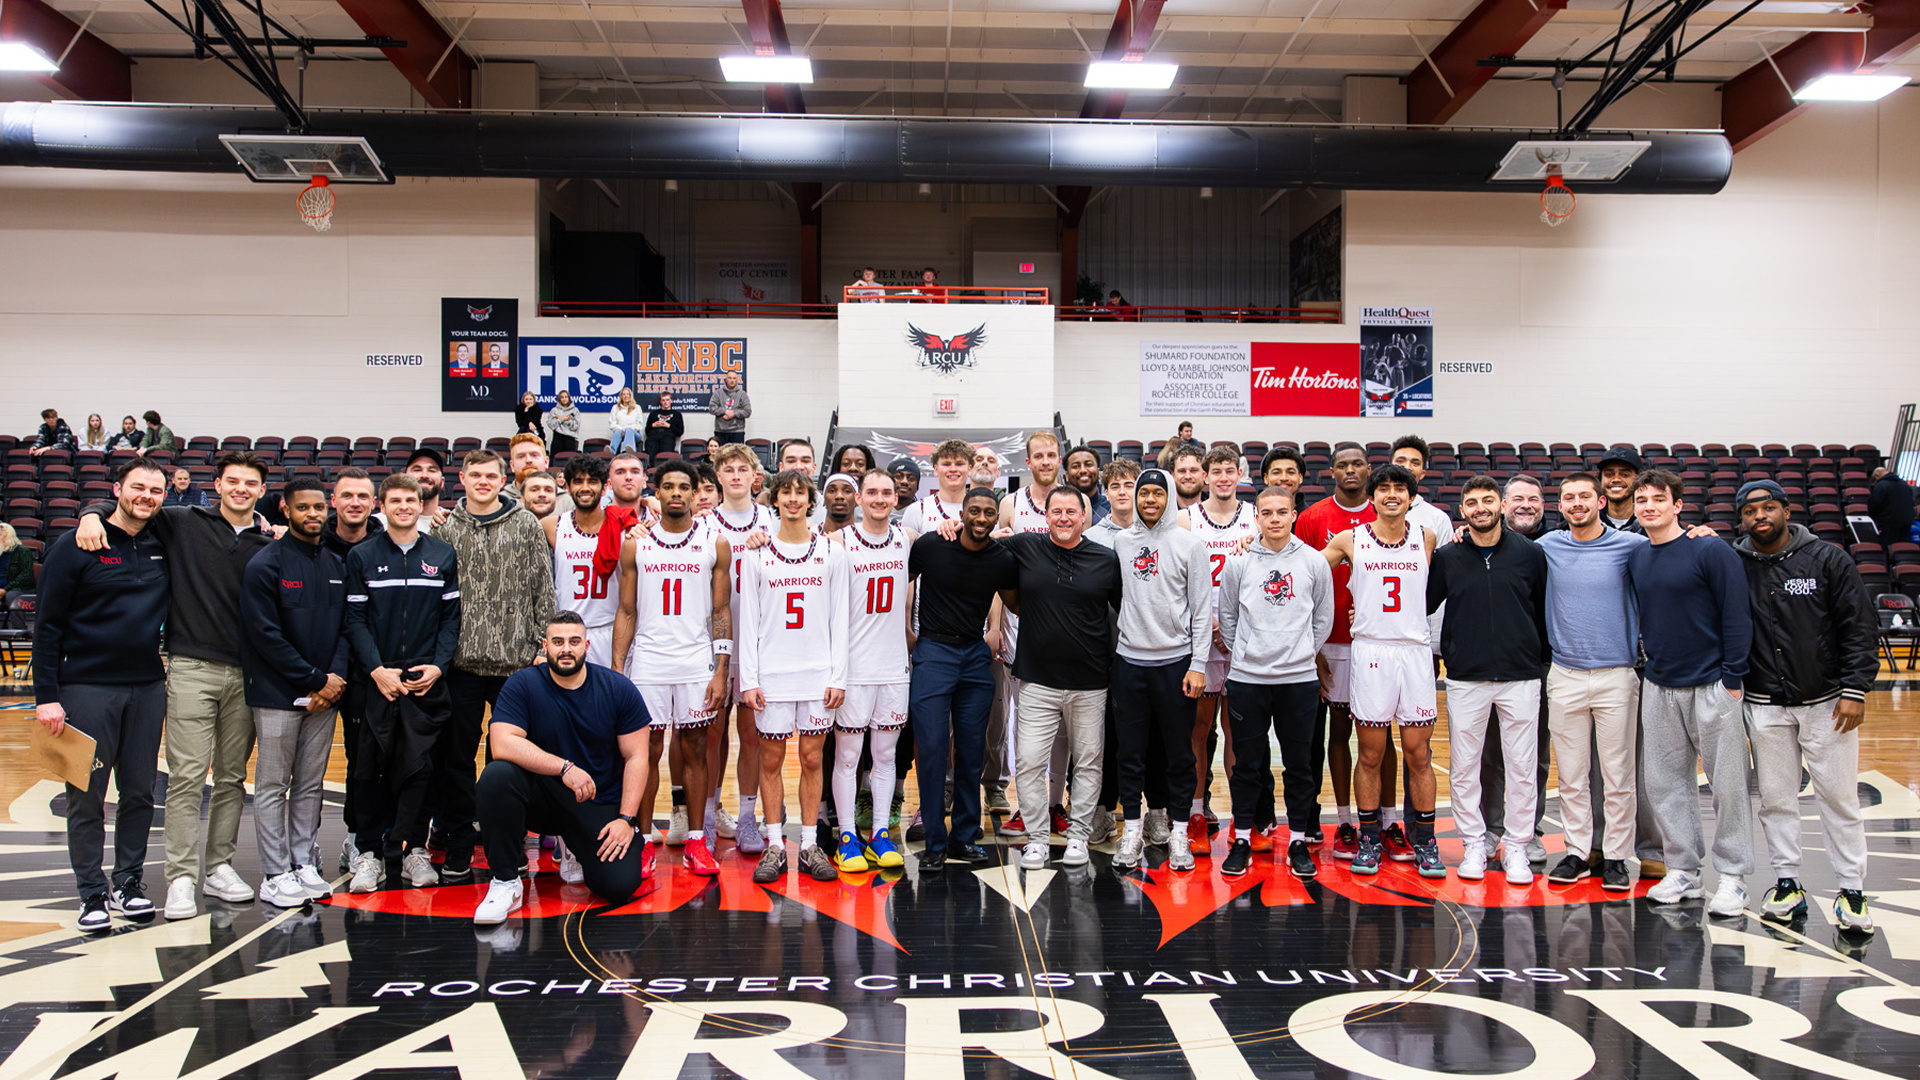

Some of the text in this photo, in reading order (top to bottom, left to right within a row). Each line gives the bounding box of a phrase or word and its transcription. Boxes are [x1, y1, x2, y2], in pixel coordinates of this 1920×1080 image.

[718, 269, 788, 278] GOLF CENTER
[853, 270, 941, 279] CTER FAMY
[1364, 308, 1430, 320] HealthQuest
[366, 355, 422, 366] RESERVED
[638, 341, 742, 372] LNBC
[932, 352, 961, 363] RCU
[1145, 352, 1188, 360] SHUMARD
[1209, 364, 1249, 372] JOHNSON
[1440, 362, 1492, 372] RESERVED
[637, 374, 742, 384] LAKE NORCENTA
[1252, 366, 1286, 388] Tim
[637, 384, 710, 394] BASKETBALL
[940, 400, 954, 410] EXIT
[566, 551, 593, 560] WARR
[644, 564, 700, 573] WARRIORS
[854, 560, 903, 574] WARRIORS
[1365, 562, 1418, 571] WARRIORS
[573, 565, 608, 600] 30
[769, 576, 822, 588] WARRIORS
[662, 578, 682, 615] 11
[866, 576, 893, 614] 10
[1383, 576, 1402, 612] 3
[22, 601, 36, 610] RC
[1888, 600, 1907, 608] RCU
[786, 592, 804, 629] 5
[372, 966, 1667, 998] ROCHESTER CHRISTIAN UNIVERSITY
